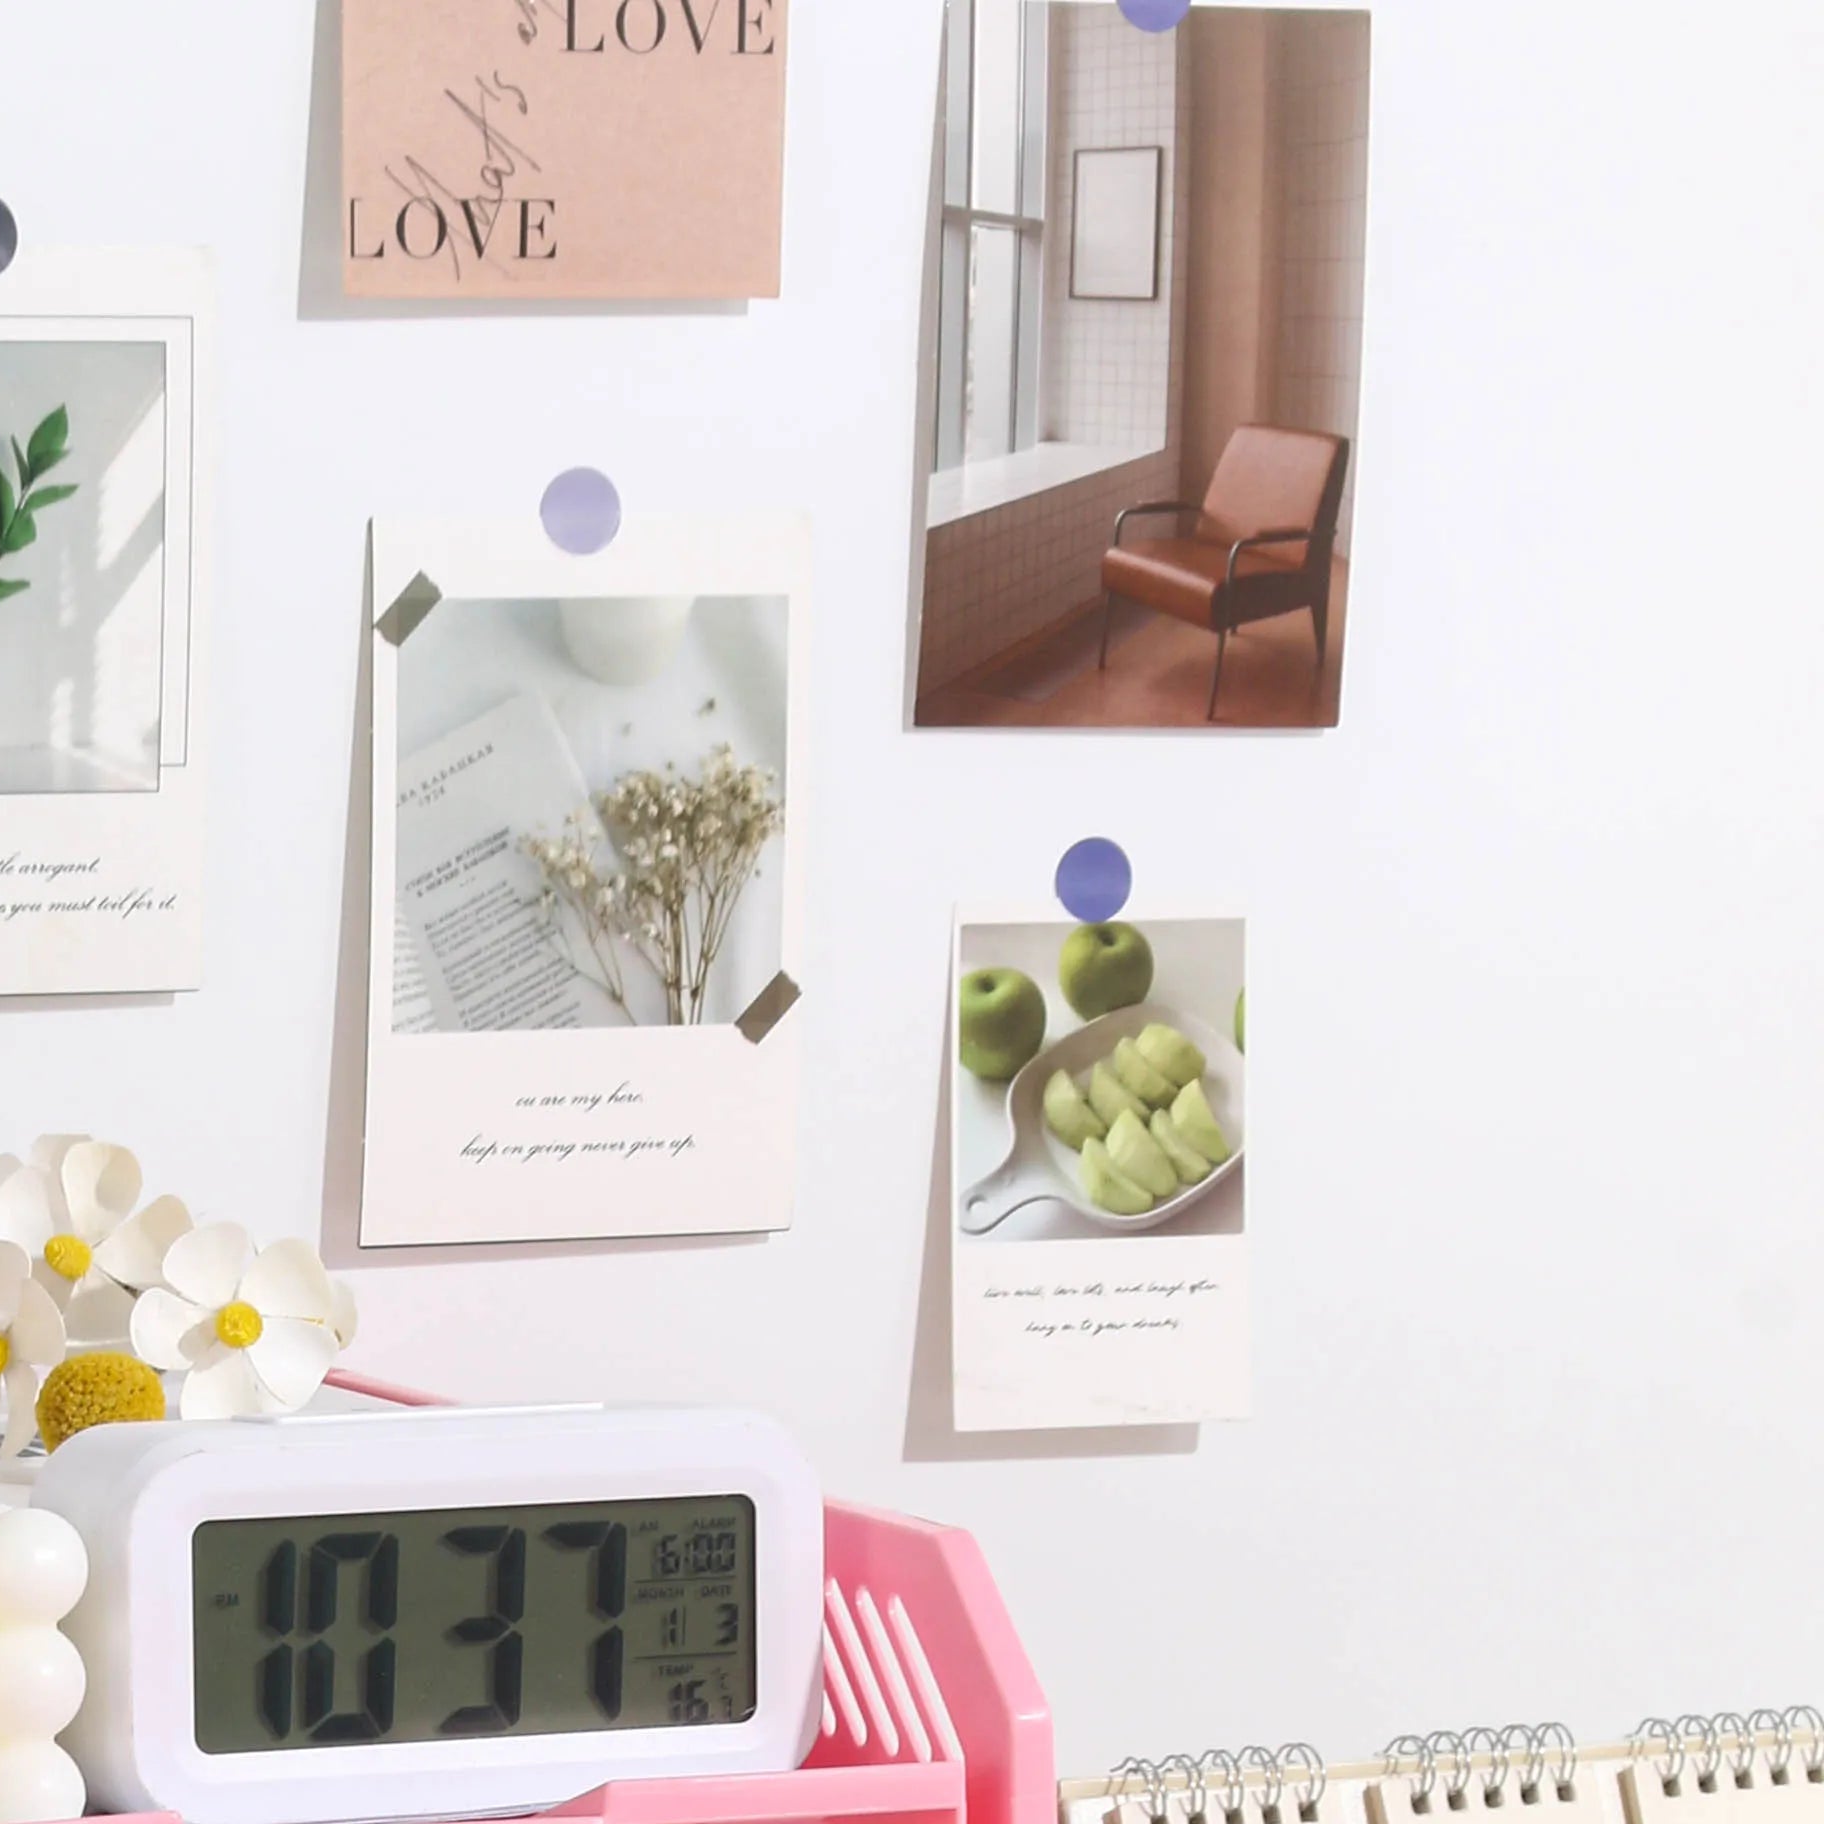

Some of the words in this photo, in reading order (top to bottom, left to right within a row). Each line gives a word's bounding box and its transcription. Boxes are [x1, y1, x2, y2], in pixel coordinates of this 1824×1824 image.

[559, 0, 774, 54] LOVE
[349, 197, 558, 260] LOVE
[3, 900, 43, 921] you
[48, 895, 97, 913] must
[539, 1094, 567, 1106] are
[570, 1092, 603, 1113] my
[521, 1139, 577, 1163] going
